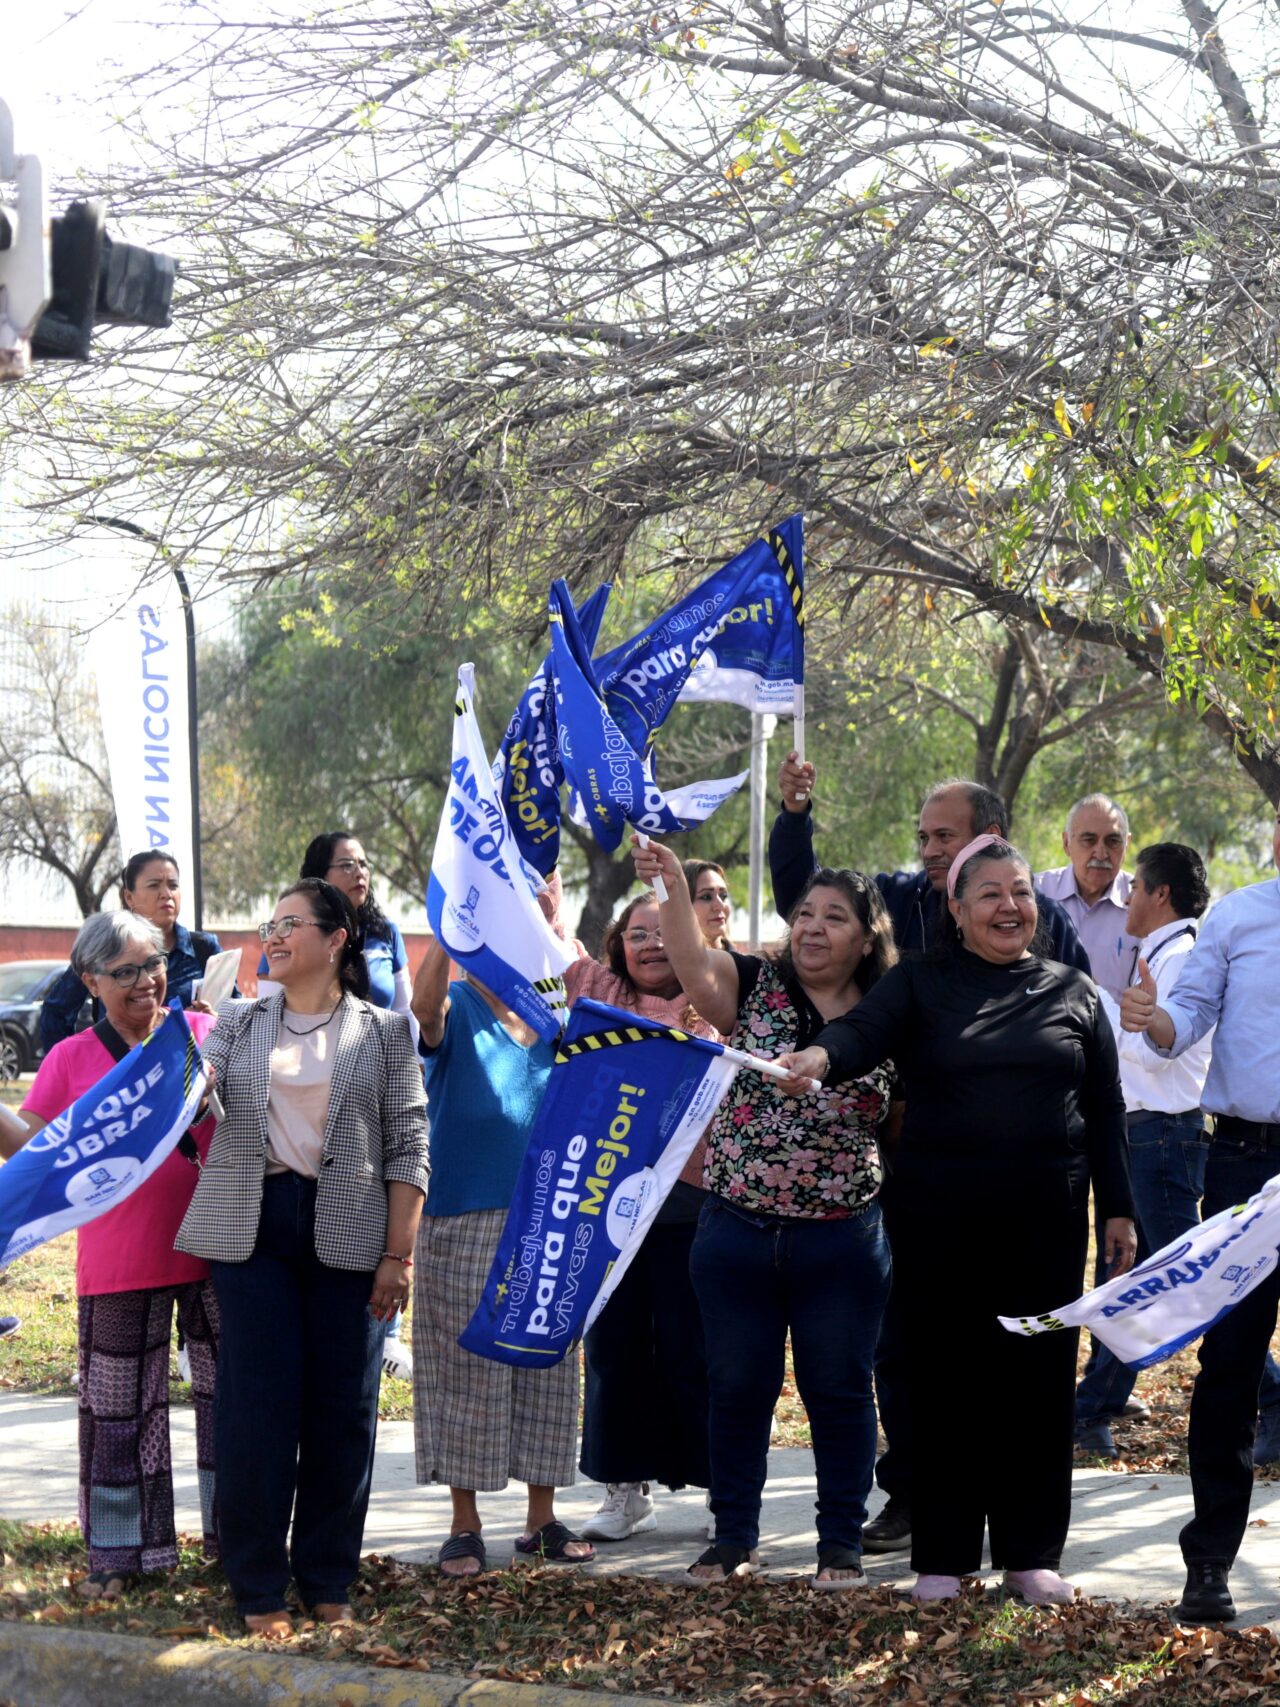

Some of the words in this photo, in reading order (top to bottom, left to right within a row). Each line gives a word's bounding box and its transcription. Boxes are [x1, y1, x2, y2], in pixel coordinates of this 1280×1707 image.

[622, 644, 686, 698] para
[510, 738, 558, 844] Mejor!
[587, 768, 601, 801] OBRAS
[578, 1083, 646, 1215] Mejor!
[526, 1232, 566, 1335] para
[552, 1135, 588, 1219] que
